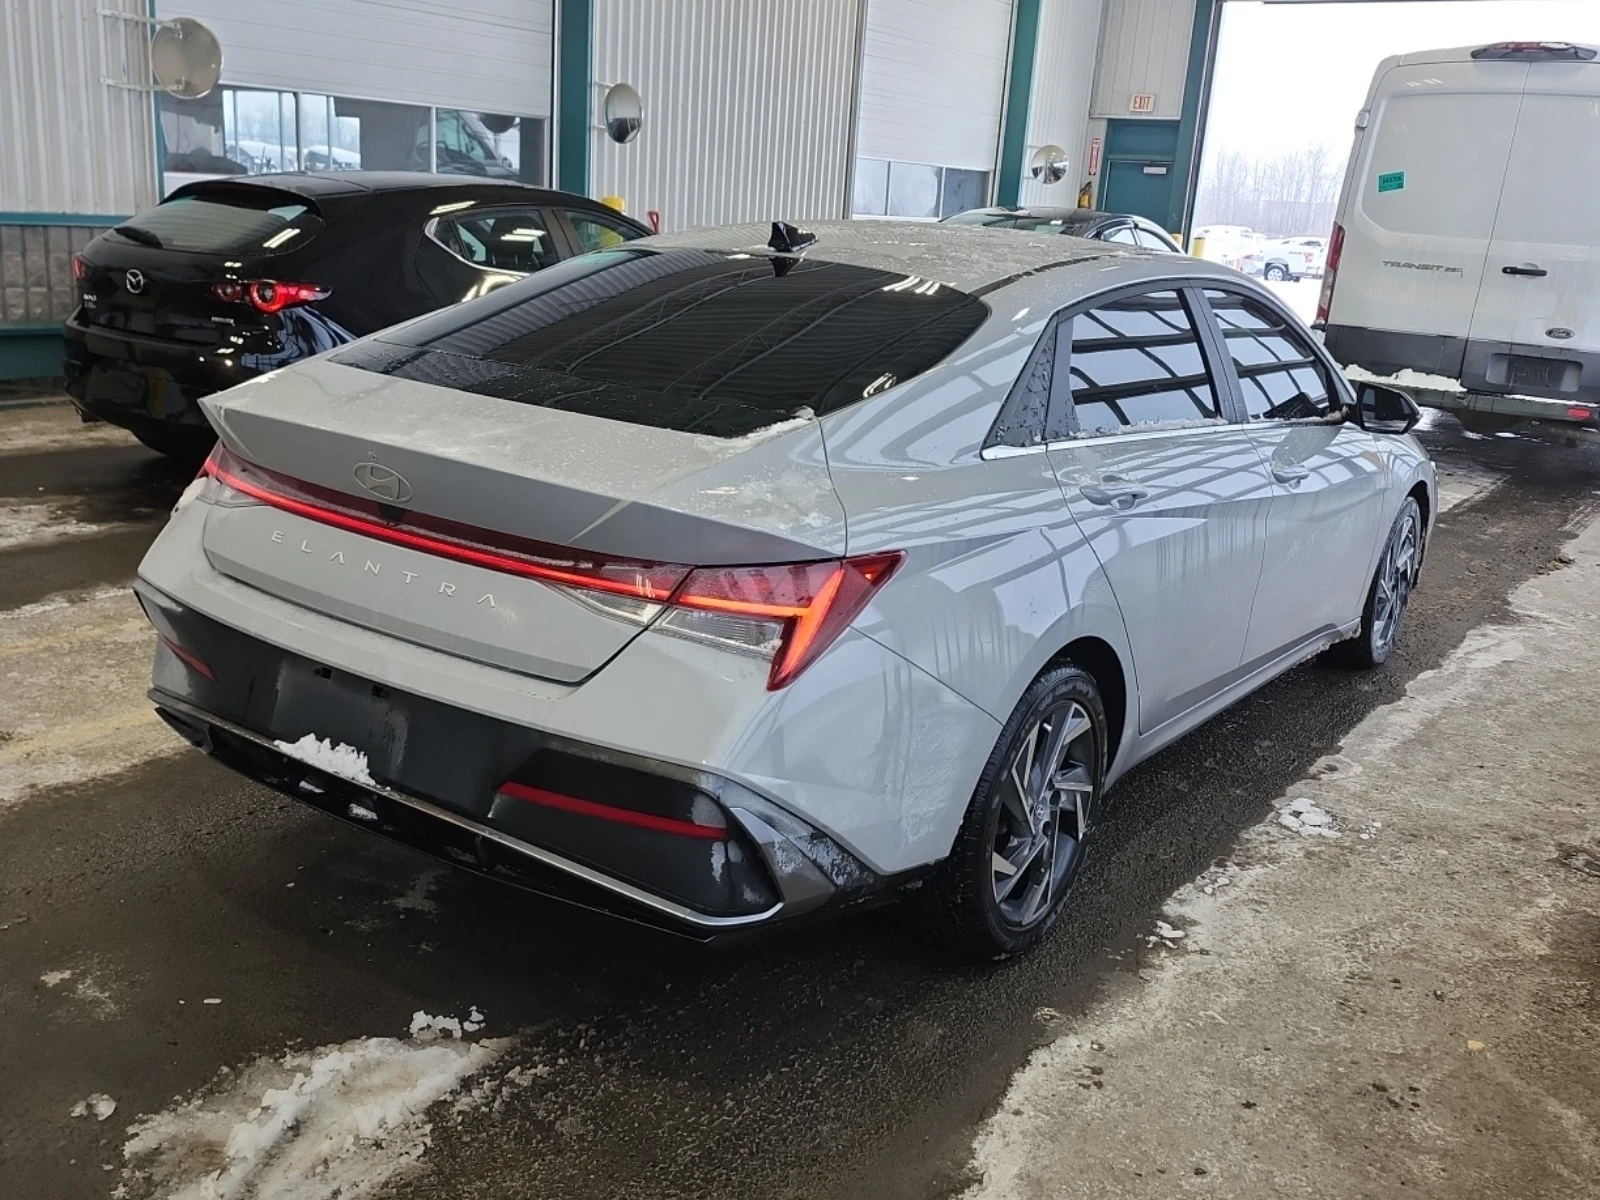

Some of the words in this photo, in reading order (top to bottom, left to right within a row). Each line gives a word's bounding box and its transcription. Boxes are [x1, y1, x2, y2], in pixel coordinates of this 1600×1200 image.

[1132, 95, 1151, 110] EXIT
[1382, 260, 1444, 272] TRANSIT
[271, 529, 498, 609] ELANTRA
